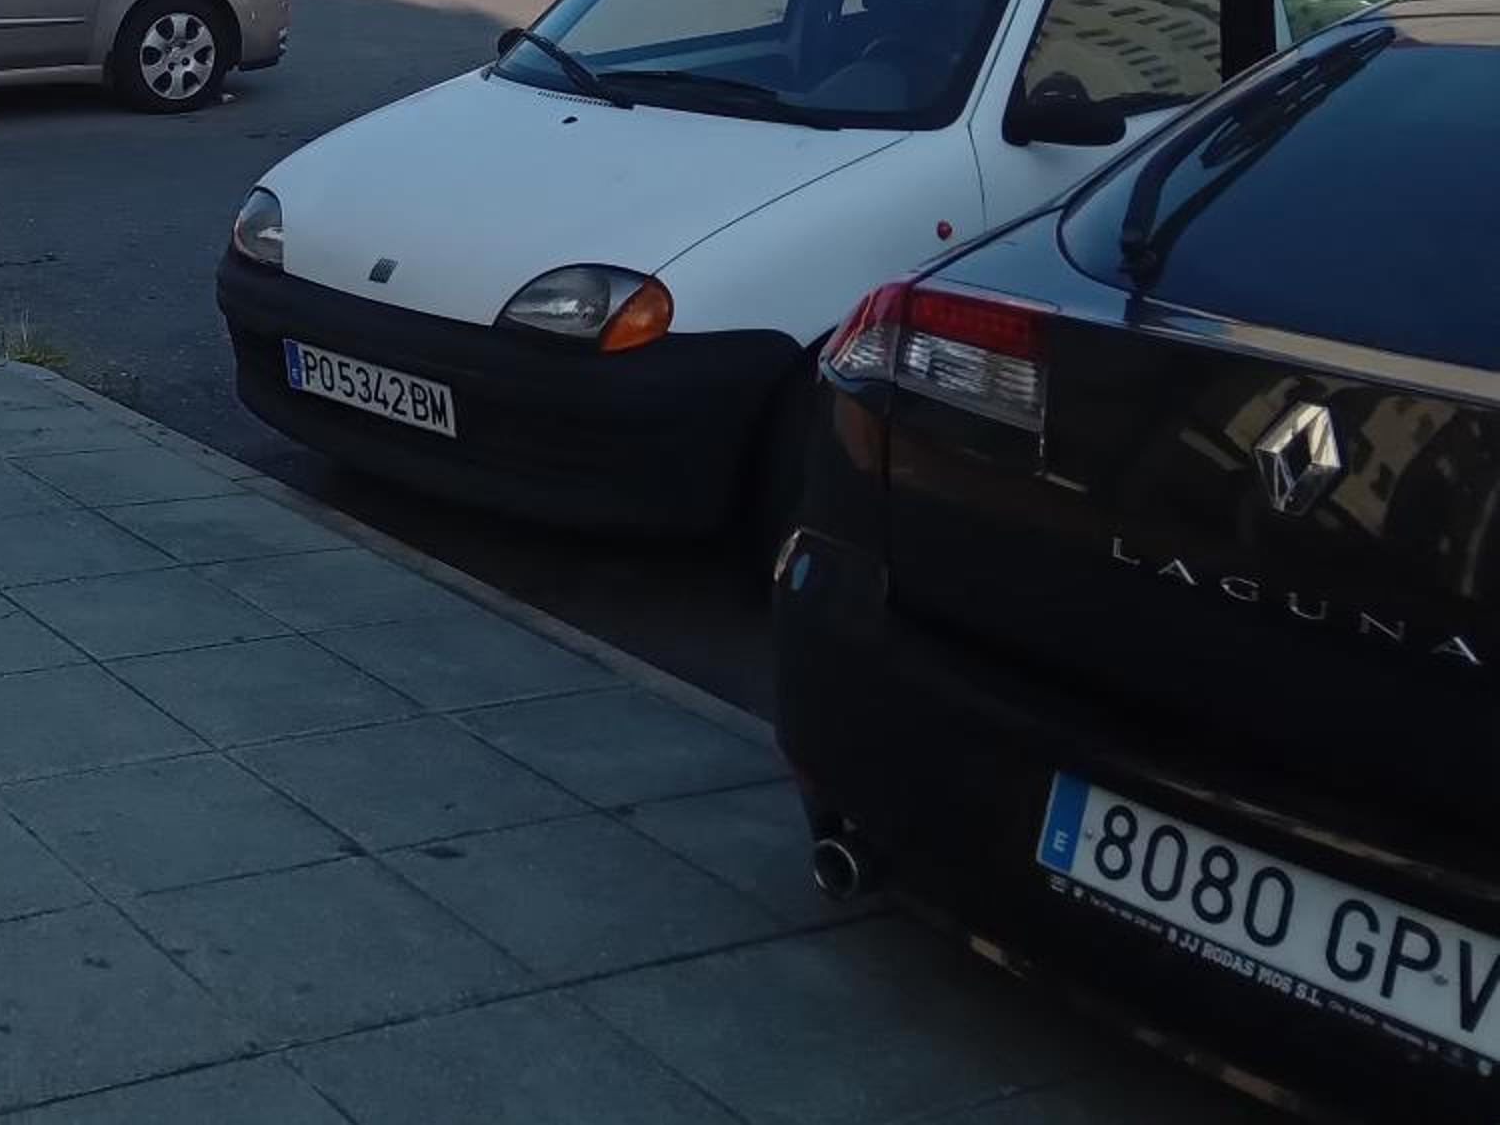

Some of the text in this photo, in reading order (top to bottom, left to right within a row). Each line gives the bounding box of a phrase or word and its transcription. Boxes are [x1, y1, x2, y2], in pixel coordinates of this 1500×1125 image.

[1113, 537, 1482, 666] LAGUNA
[1052, 831, 1069, 853] E
[1094, 805, 1500, 1034] 8080 GPV
[1258, 966, 1294, 993] MOS
